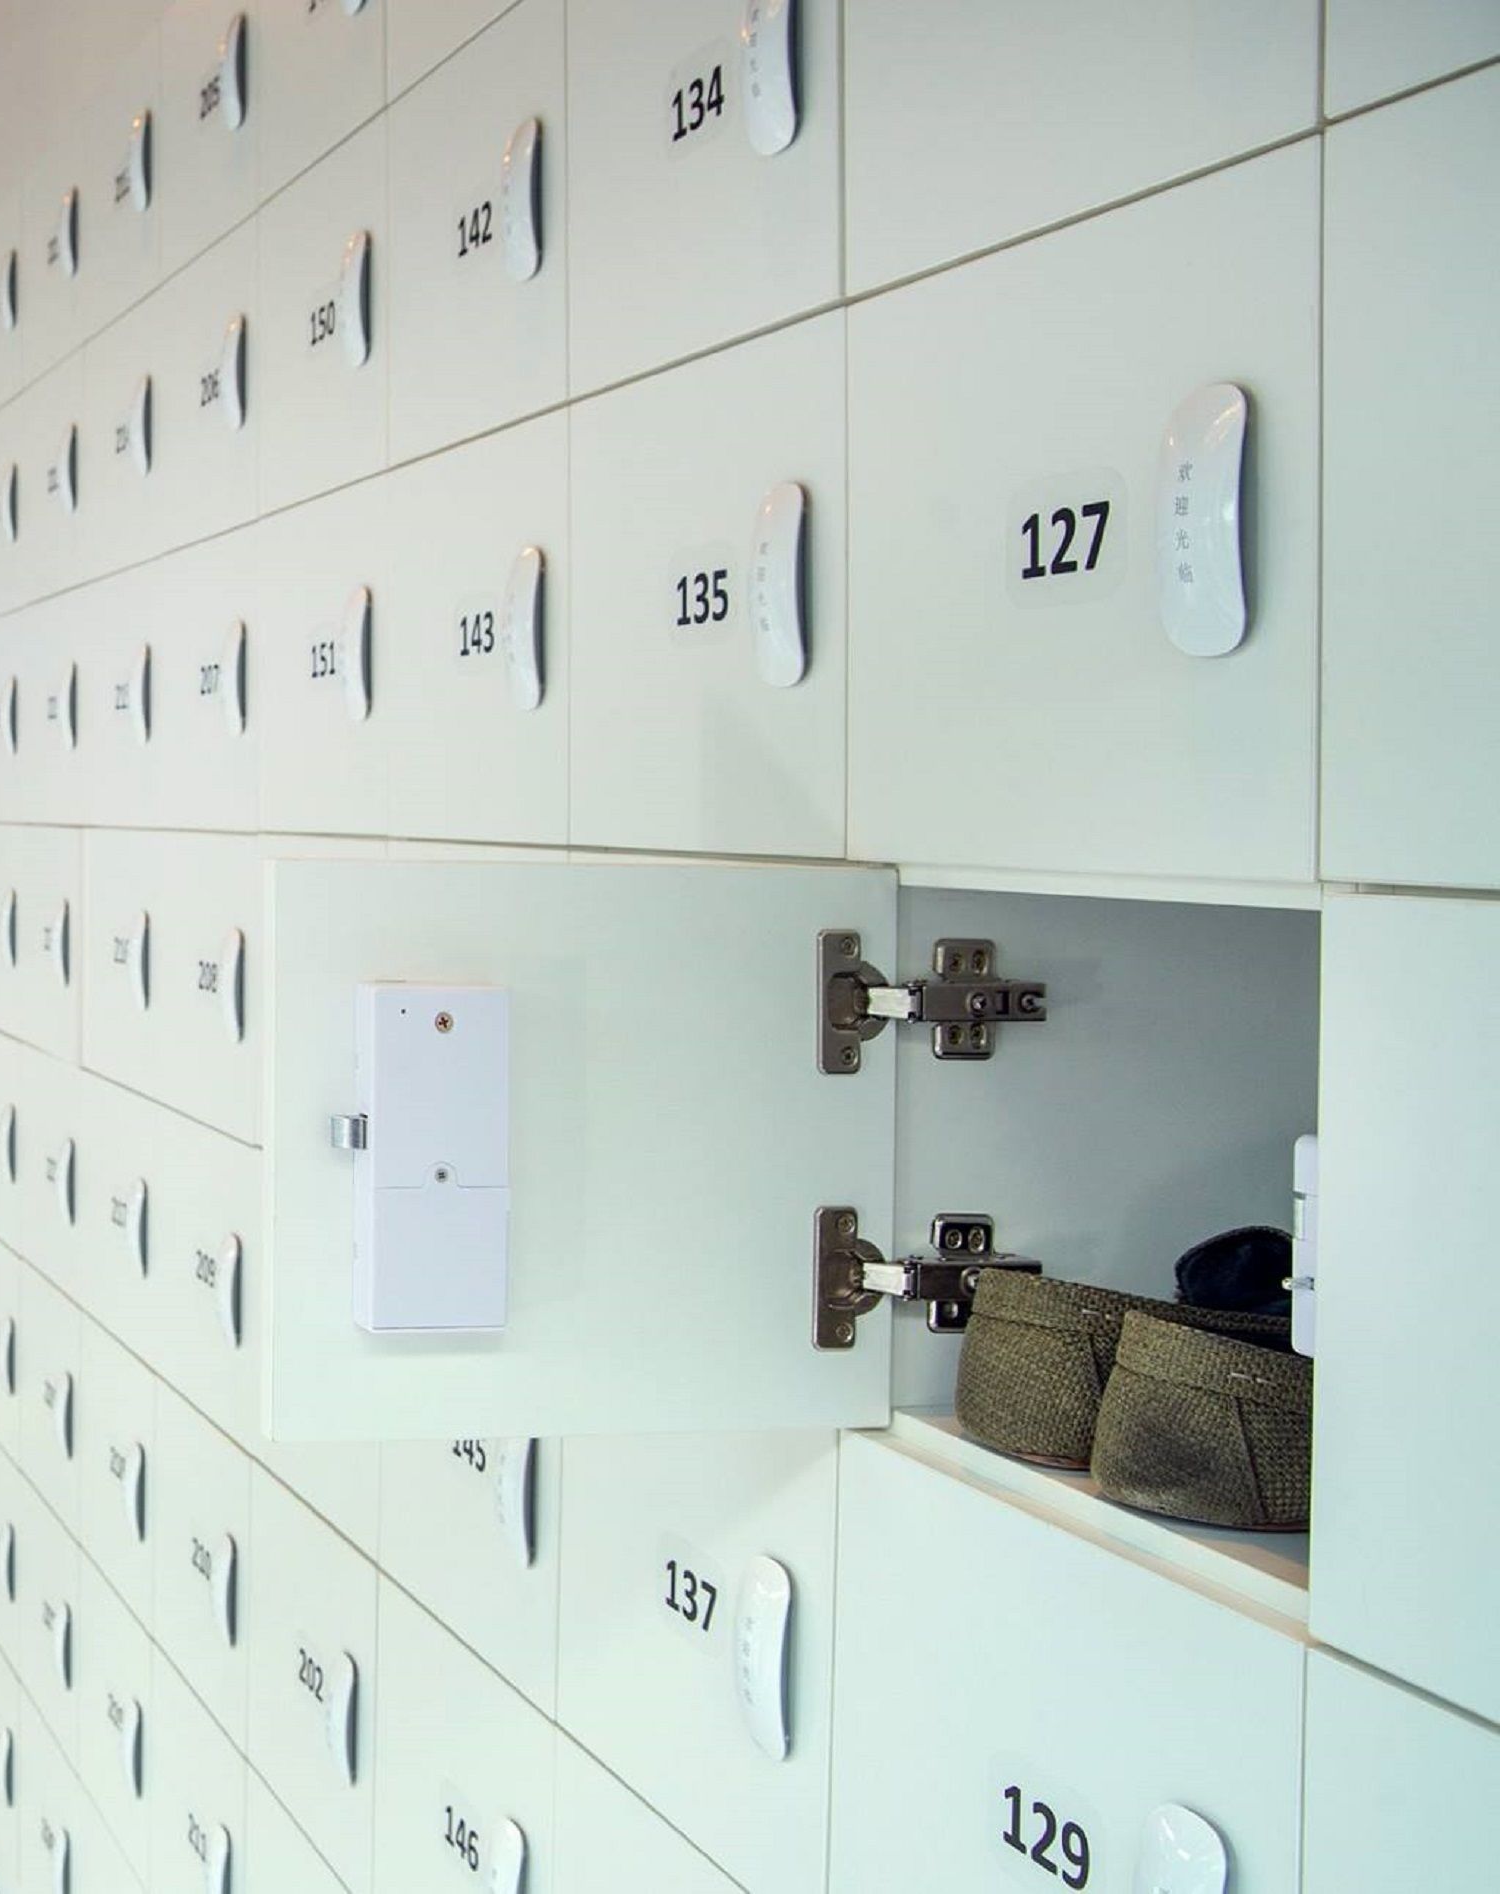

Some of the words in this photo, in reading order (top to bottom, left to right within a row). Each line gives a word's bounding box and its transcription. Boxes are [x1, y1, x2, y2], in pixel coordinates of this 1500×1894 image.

[672, 64, 725, 143] 134
[457, 201, 493, 259] 142
[311, 300, 336, 346] 150
[1021, 500, 1111, 580] 127
[676, 569, 730, 627] 135
[311, 643, 337, 679] 151
[460, 611, 495, 657] 143
[665, 1560, 718, 1632] 137
[298, 1648, 326, 1704] 202
[444, 1805, 480, 1872] 146
[1002, 1785, 1091, 1892] 129
